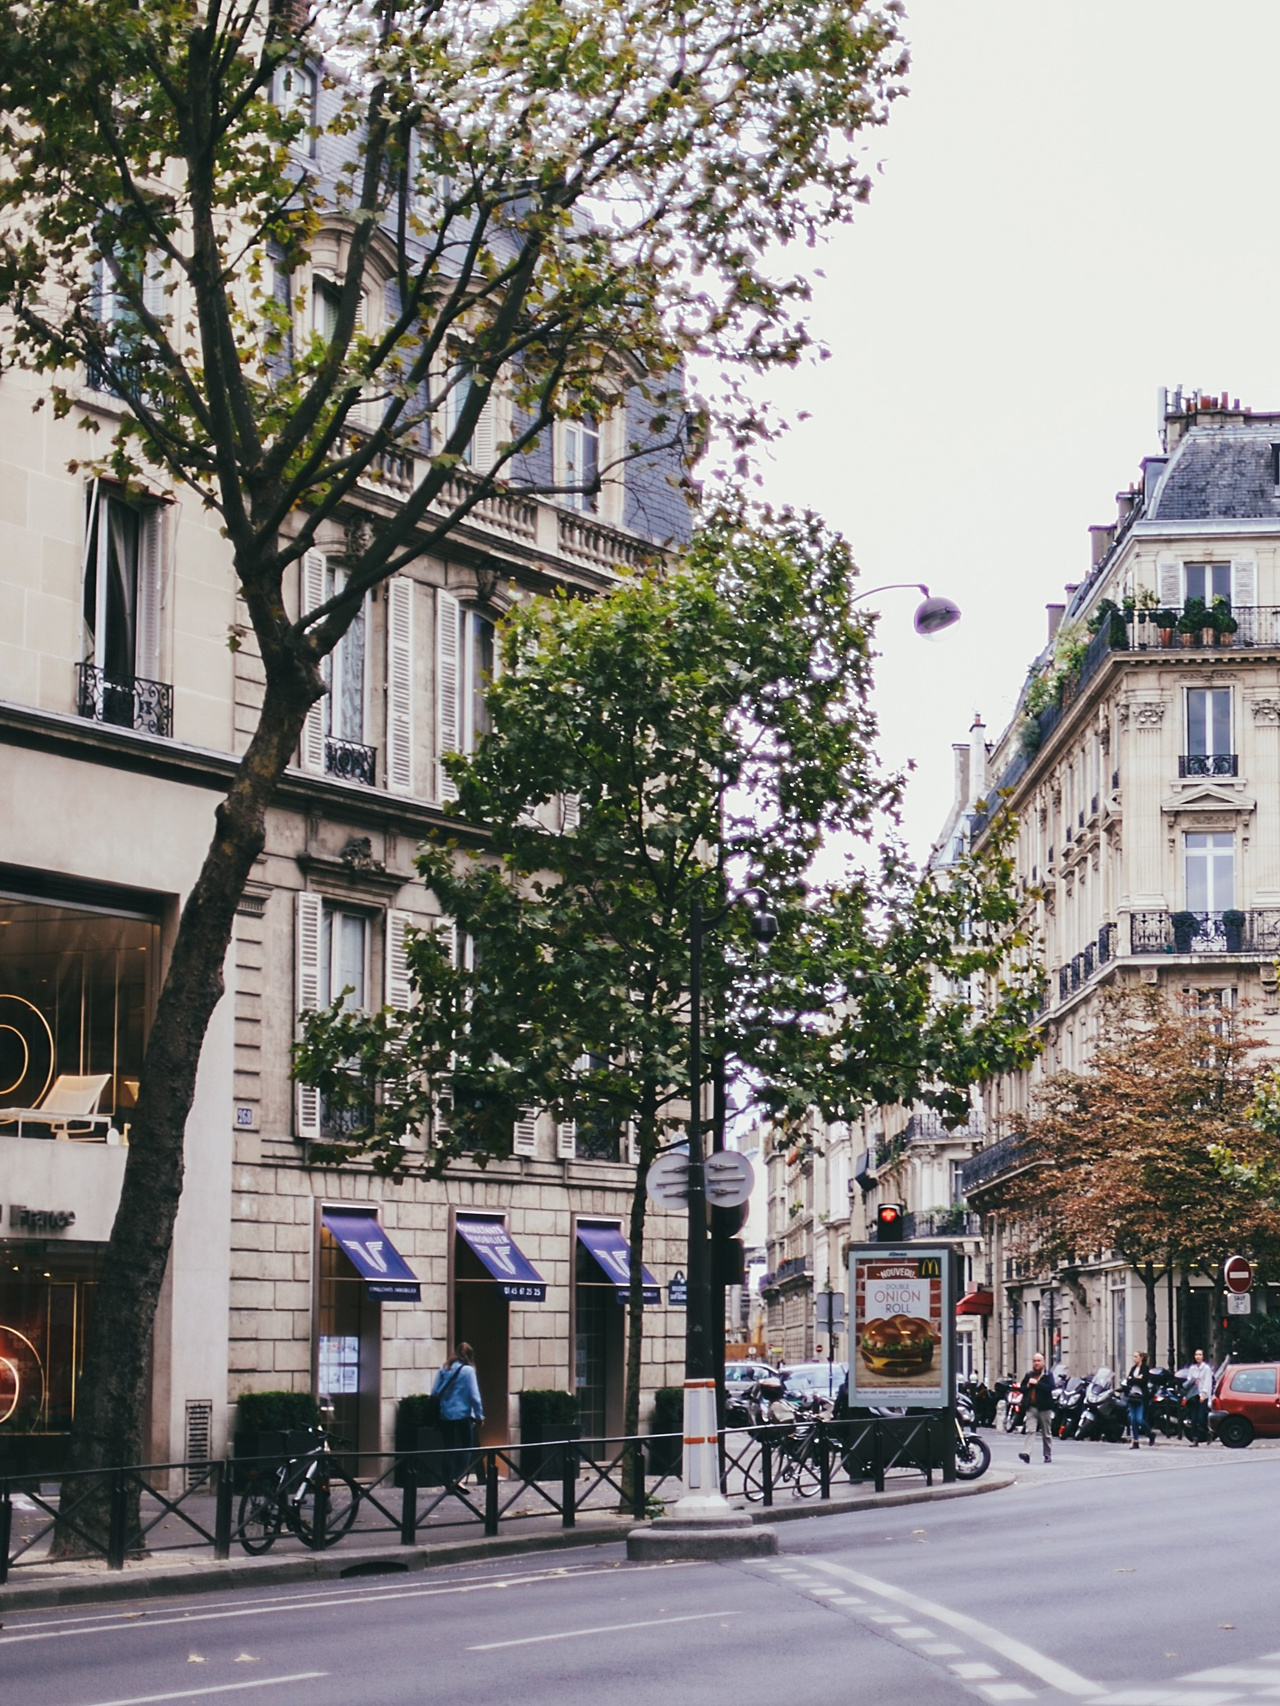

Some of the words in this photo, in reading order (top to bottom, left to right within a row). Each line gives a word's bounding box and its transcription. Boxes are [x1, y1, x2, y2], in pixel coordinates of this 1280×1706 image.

[9, 1205, 76, 1229] France
[880, 1267, 915, 1278] NOUVEAU
[874, 1290, 921, 1303] ONION
[885, 1303, 911, 1314] ROLL
